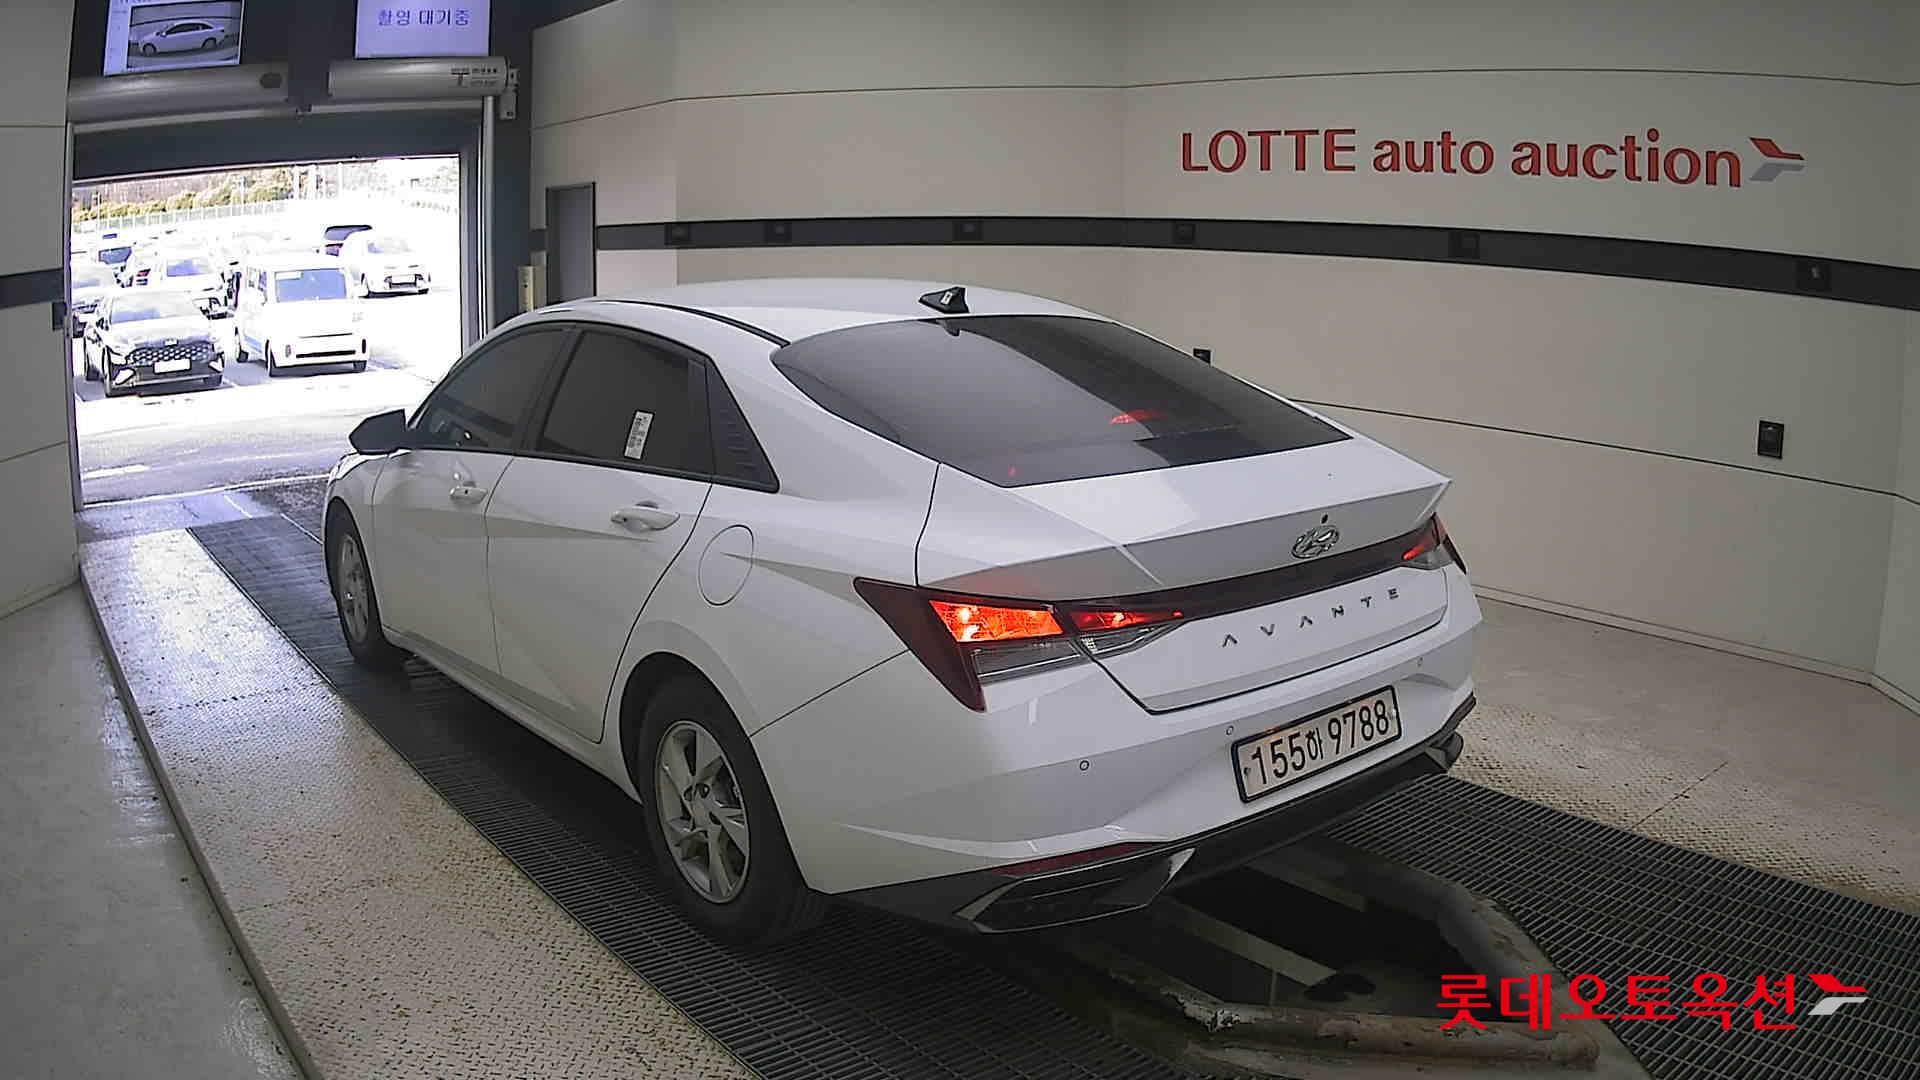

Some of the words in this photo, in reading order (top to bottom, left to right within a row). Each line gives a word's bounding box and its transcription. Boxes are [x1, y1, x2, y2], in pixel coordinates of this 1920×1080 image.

[419, 8, 470, 26] 대기중
[1181, 128, 1357, 173] LOTTE
[1372, 130, 1495, 176] auto
[1511, 128, 1742, 188] auction
[1222, 587, 1400, 648] AVANTE
